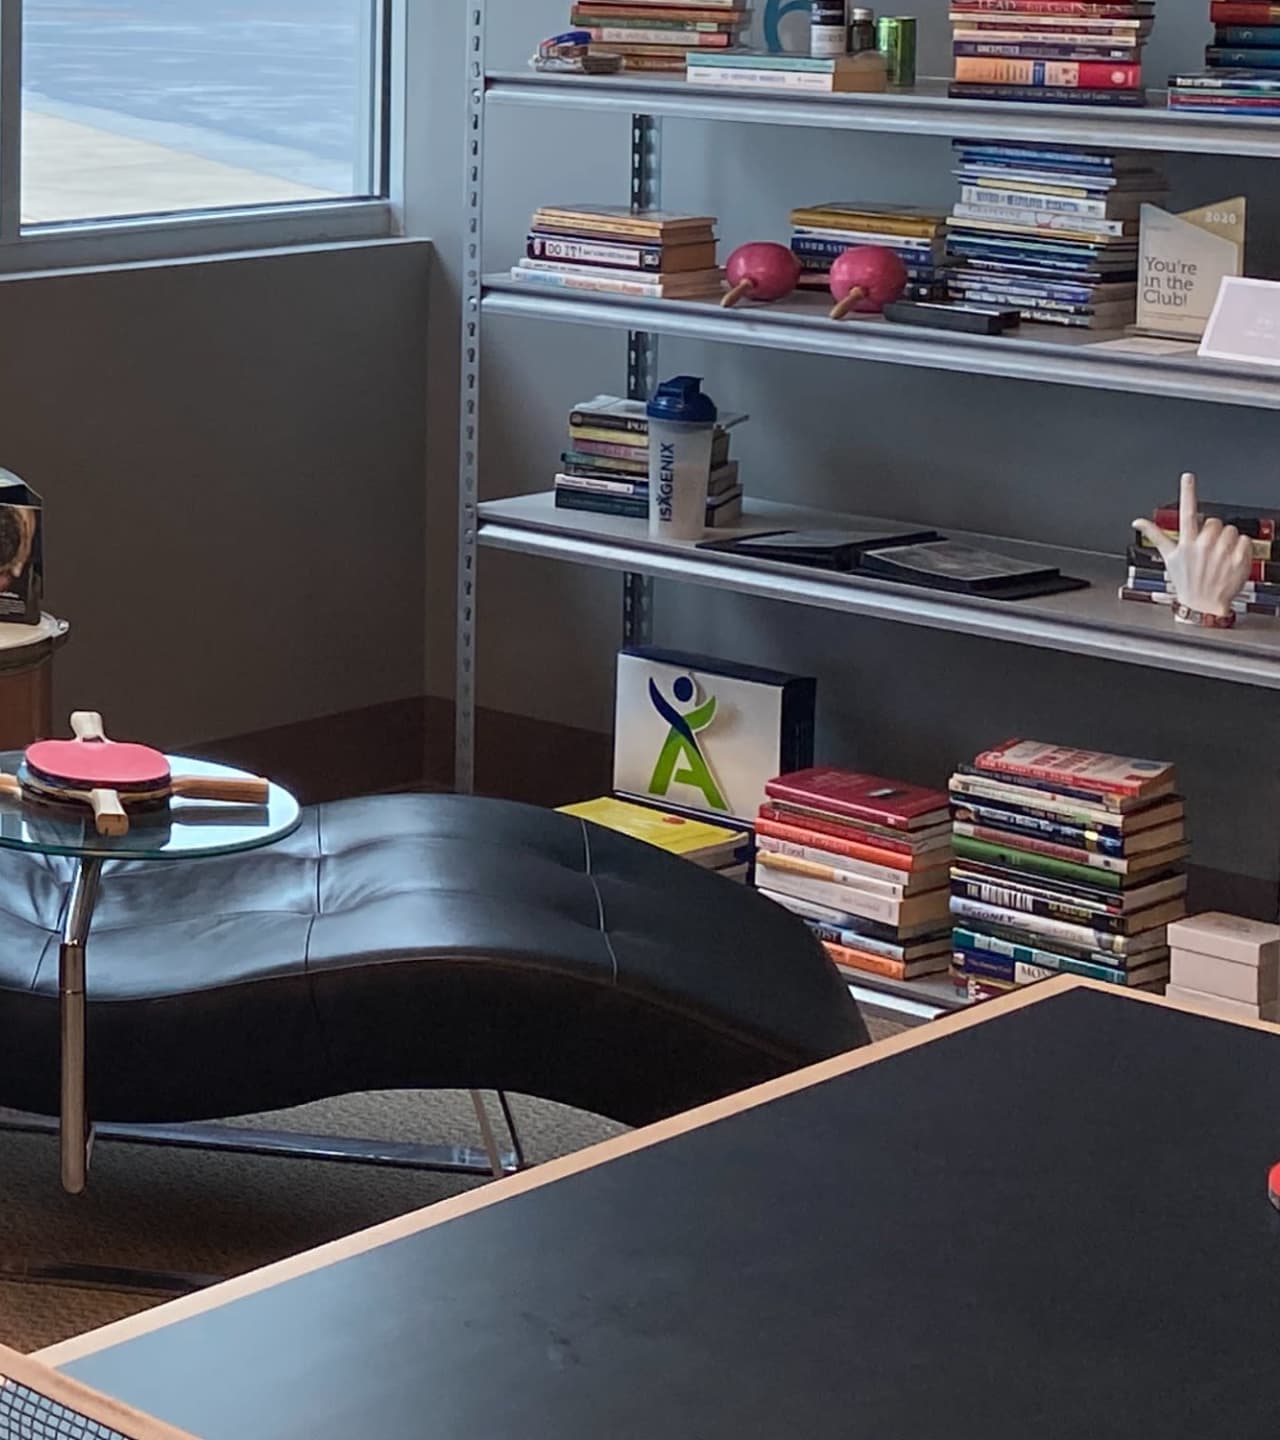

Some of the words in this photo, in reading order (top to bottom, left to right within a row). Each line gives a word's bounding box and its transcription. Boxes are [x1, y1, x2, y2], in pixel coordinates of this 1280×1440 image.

[1205, 211, 1237, 225] 2020
[547, 240, 562, 254] DO
[1144, 256, 1198, 276] You're
[1144, 276, 1161, 288] in
[1166, 276, 1195, 292] the
[1143, 289, 1188, 306] Club!
